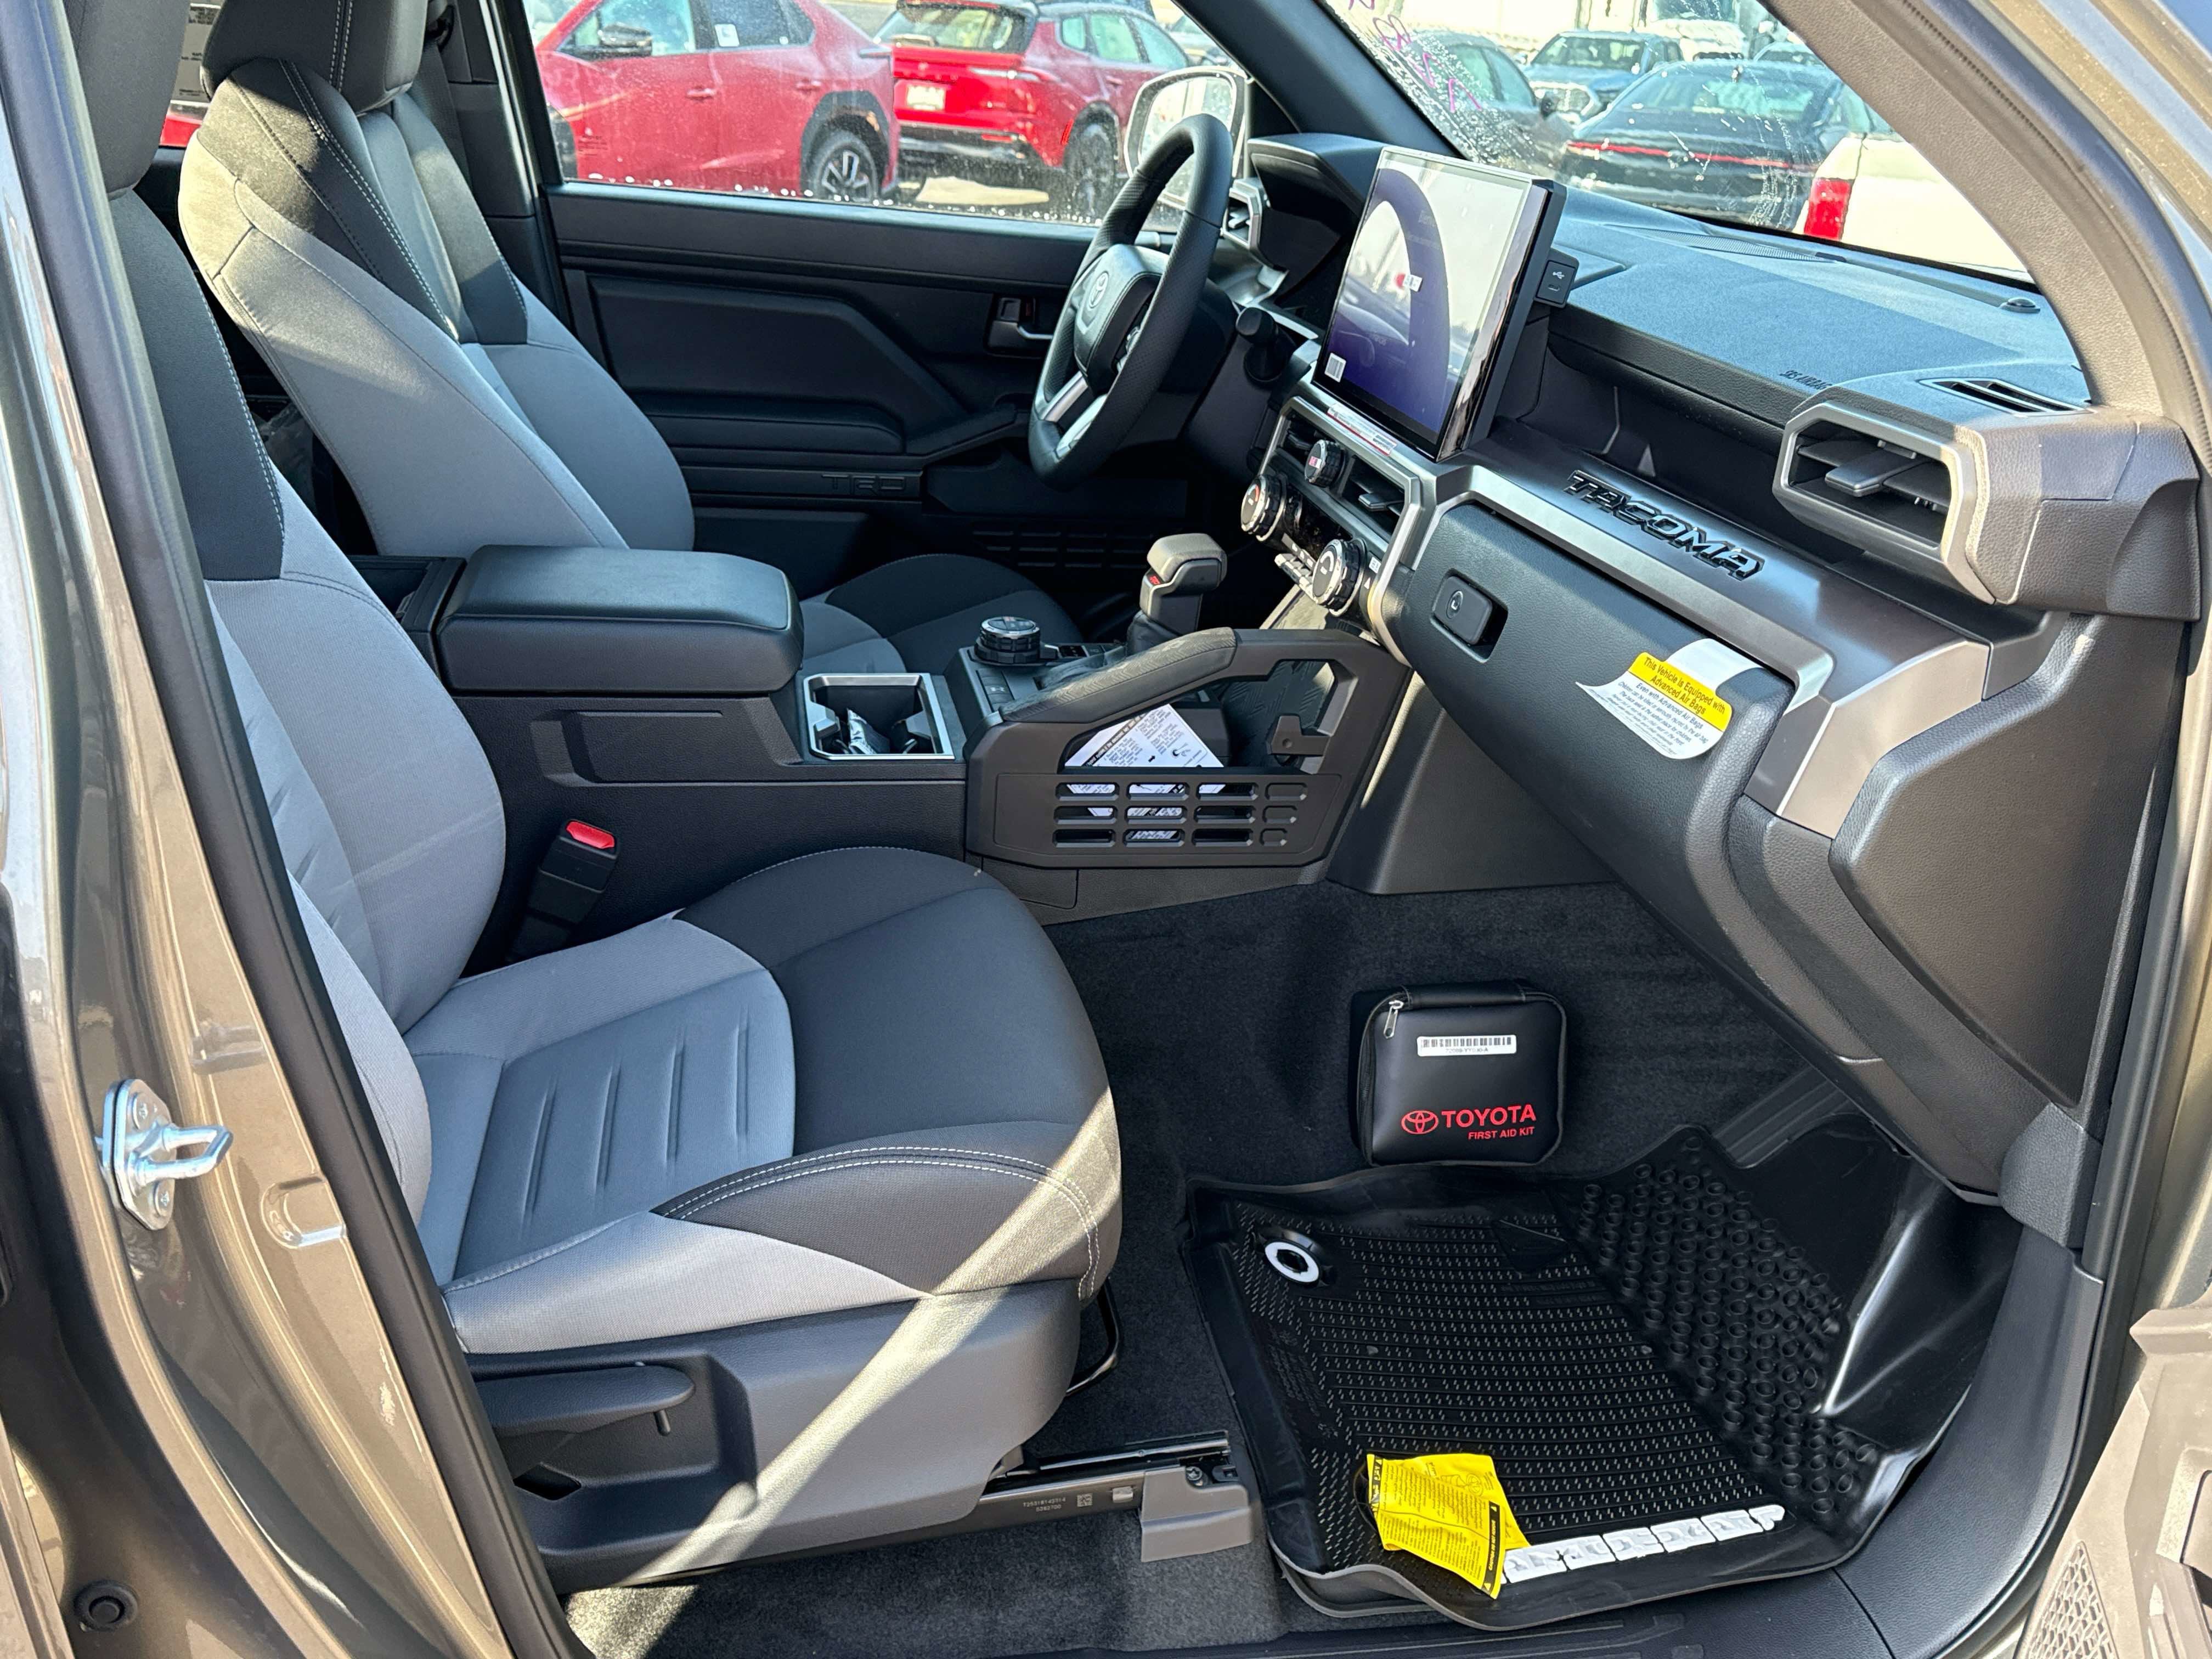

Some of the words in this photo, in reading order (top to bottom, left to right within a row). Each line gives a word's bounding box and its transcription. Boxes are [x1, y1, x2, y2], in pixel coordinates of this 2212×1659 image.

[821, 473, 906, 495] TRD
[1564, 470, 1765, 582] TACOMA
[1644, 657, 1656, 670] This
[1657, 665, 1678, 683] Vehicle
[1677, 676, 1684, 687] is
[1684, 682, 1714, 705] Equipped
[1713, 701, 1725, 714] with
[1650, 675, 1680, 697] Advanced
[1679, 693, 1690, 703] Air
[1689, 699, 1706, 714] Bags
[1635, 682, 1649, 693] Even
[1648, 692, 1660, 700] with
[1658, 697, 1683, 715] Advanced
[1690, 717, 1703, 729] Bags
[1441, 1104, 1537, 1128] TOYOTA
[1468, 1130, 1498, 1141] FIRST
[1499, 1128, 1517, 1138] AID
[1519, 1126, 1535, 1137] KIT
